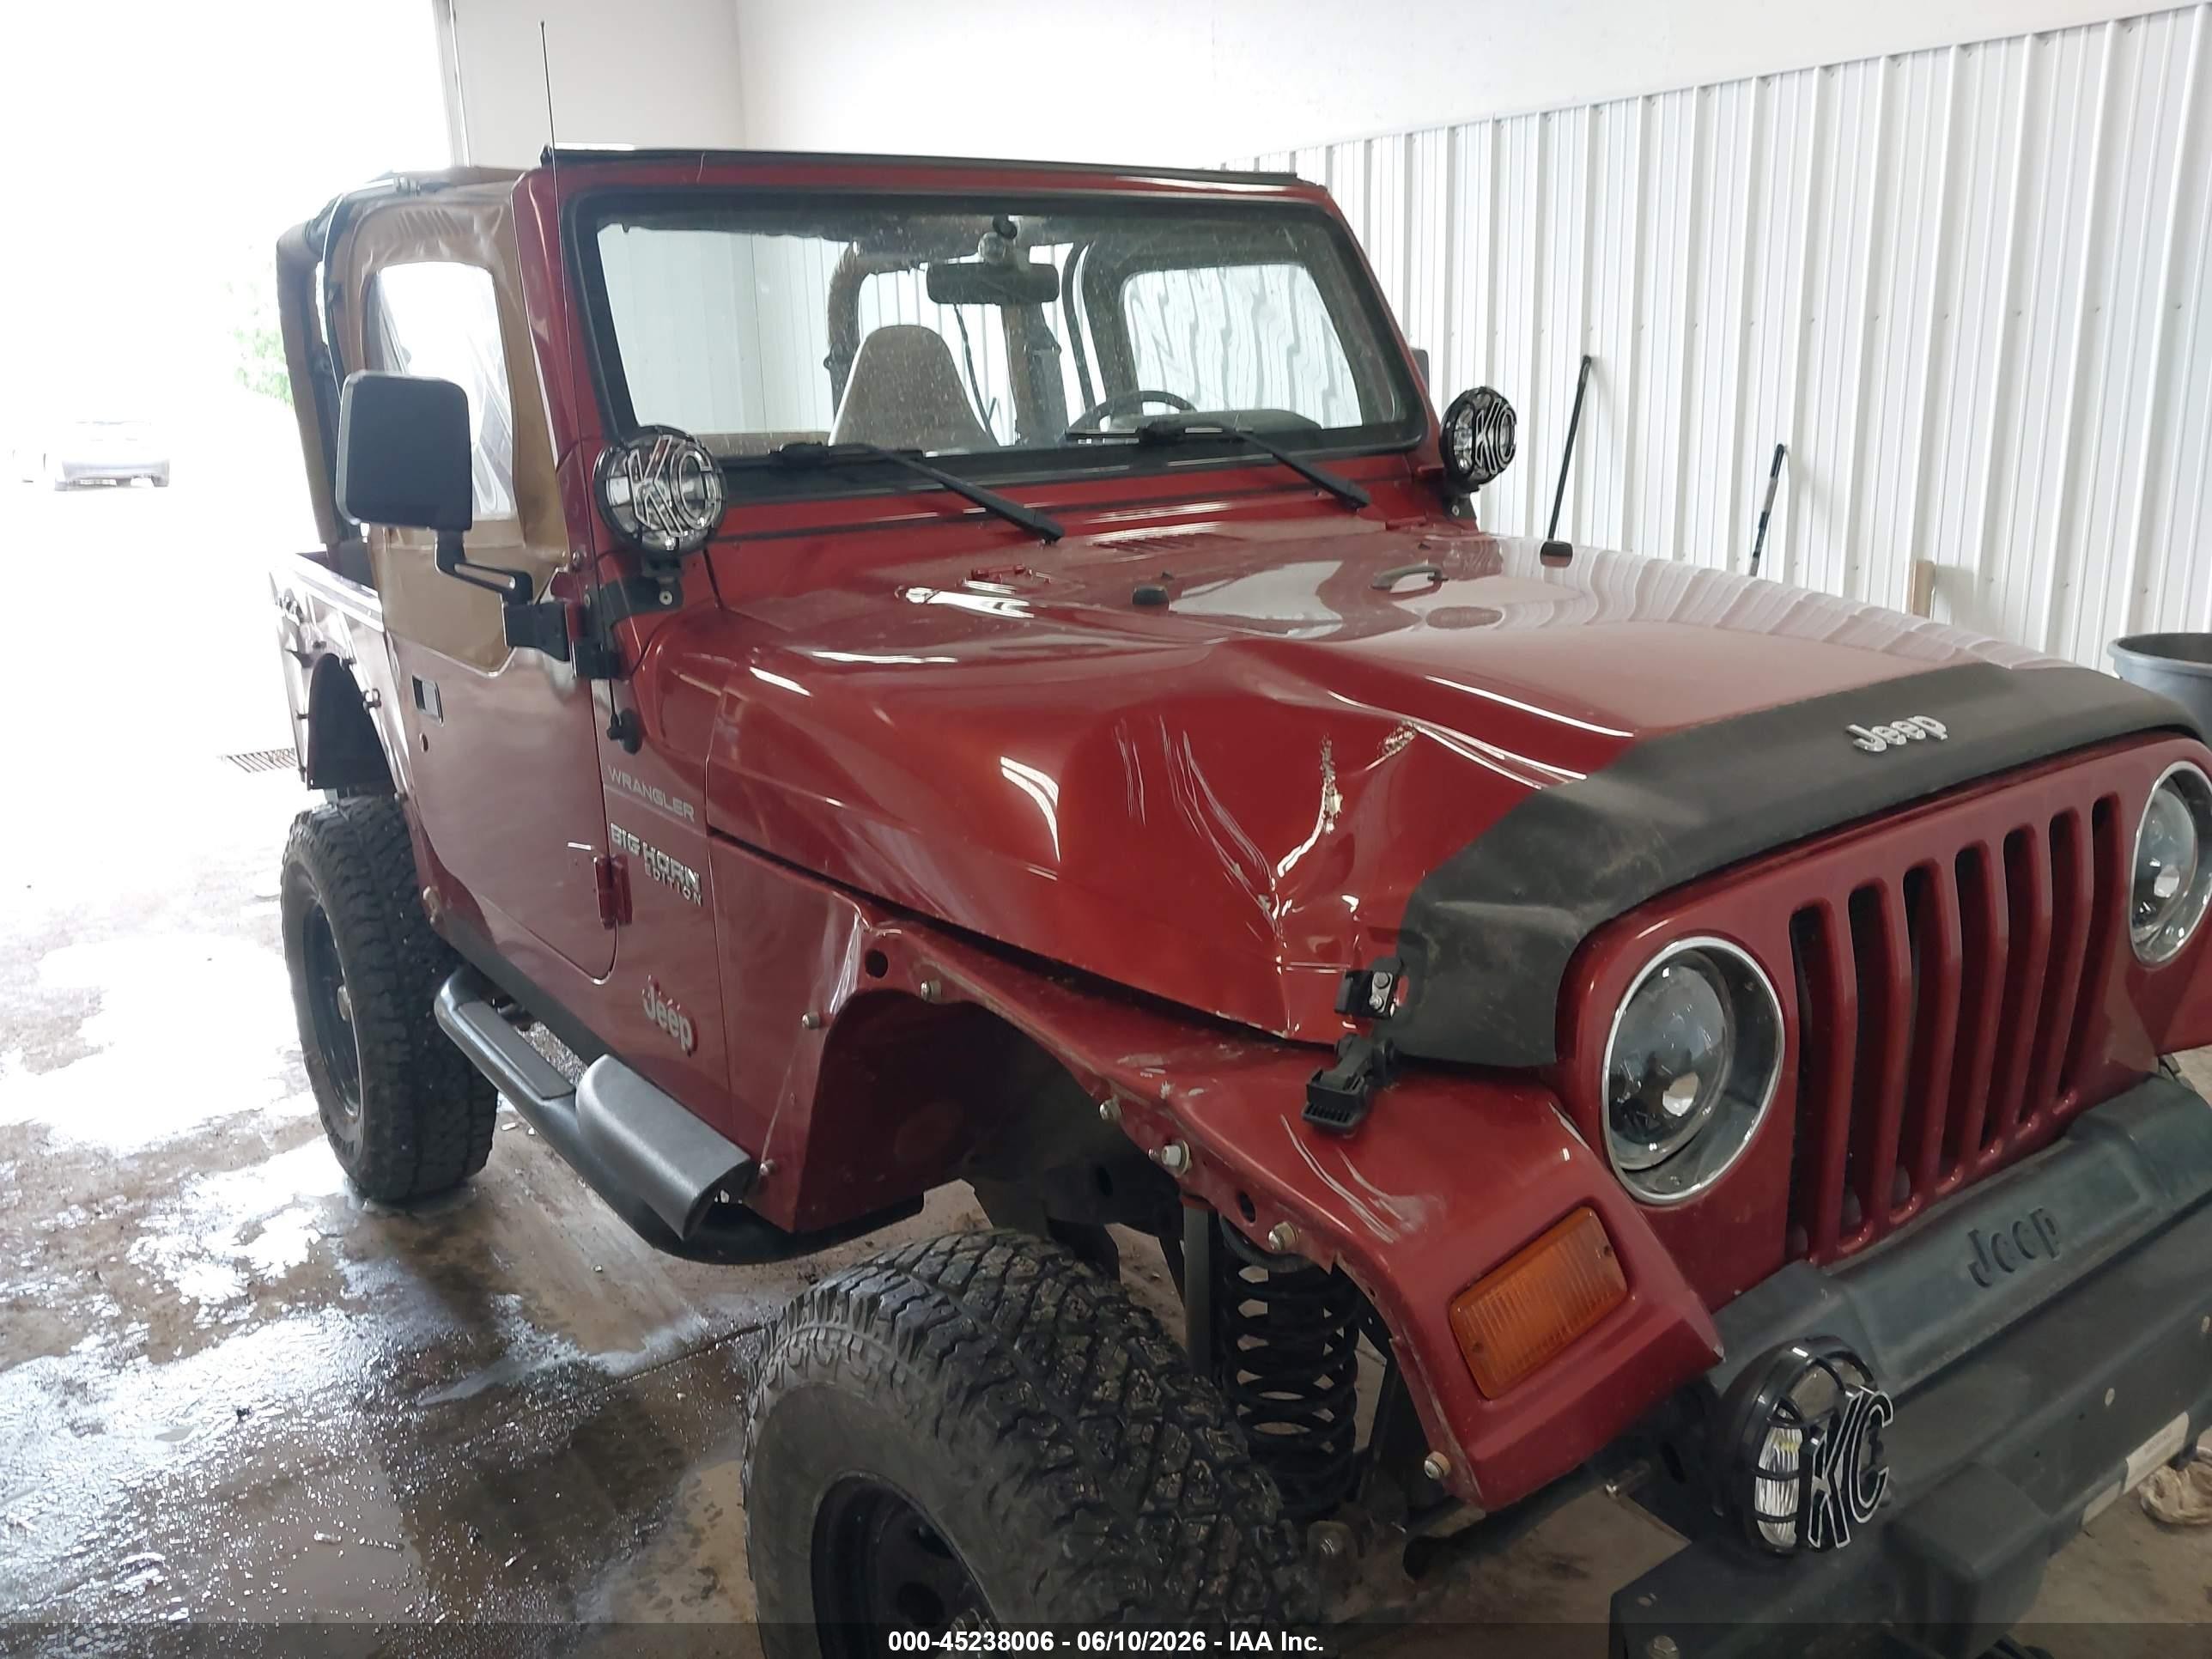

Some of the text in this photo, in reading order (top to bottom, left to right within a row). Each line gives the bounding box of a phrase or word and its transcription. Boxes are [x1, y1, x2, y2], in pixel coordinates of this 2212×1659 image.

[628, 434, 716, 537] KC
[1847, 715, 1948, 752] Jeep
[608, 763, 695, 822] WRANGLER
[611, 822, 702, 893] BIG HORN
[646, 862, 702, 907] EDITION
[642, 979, 697, 1055] Jeep
[1967, 1206, 2063, 1288] Jeep
[1808, 1389, 1893, 1548] KC
